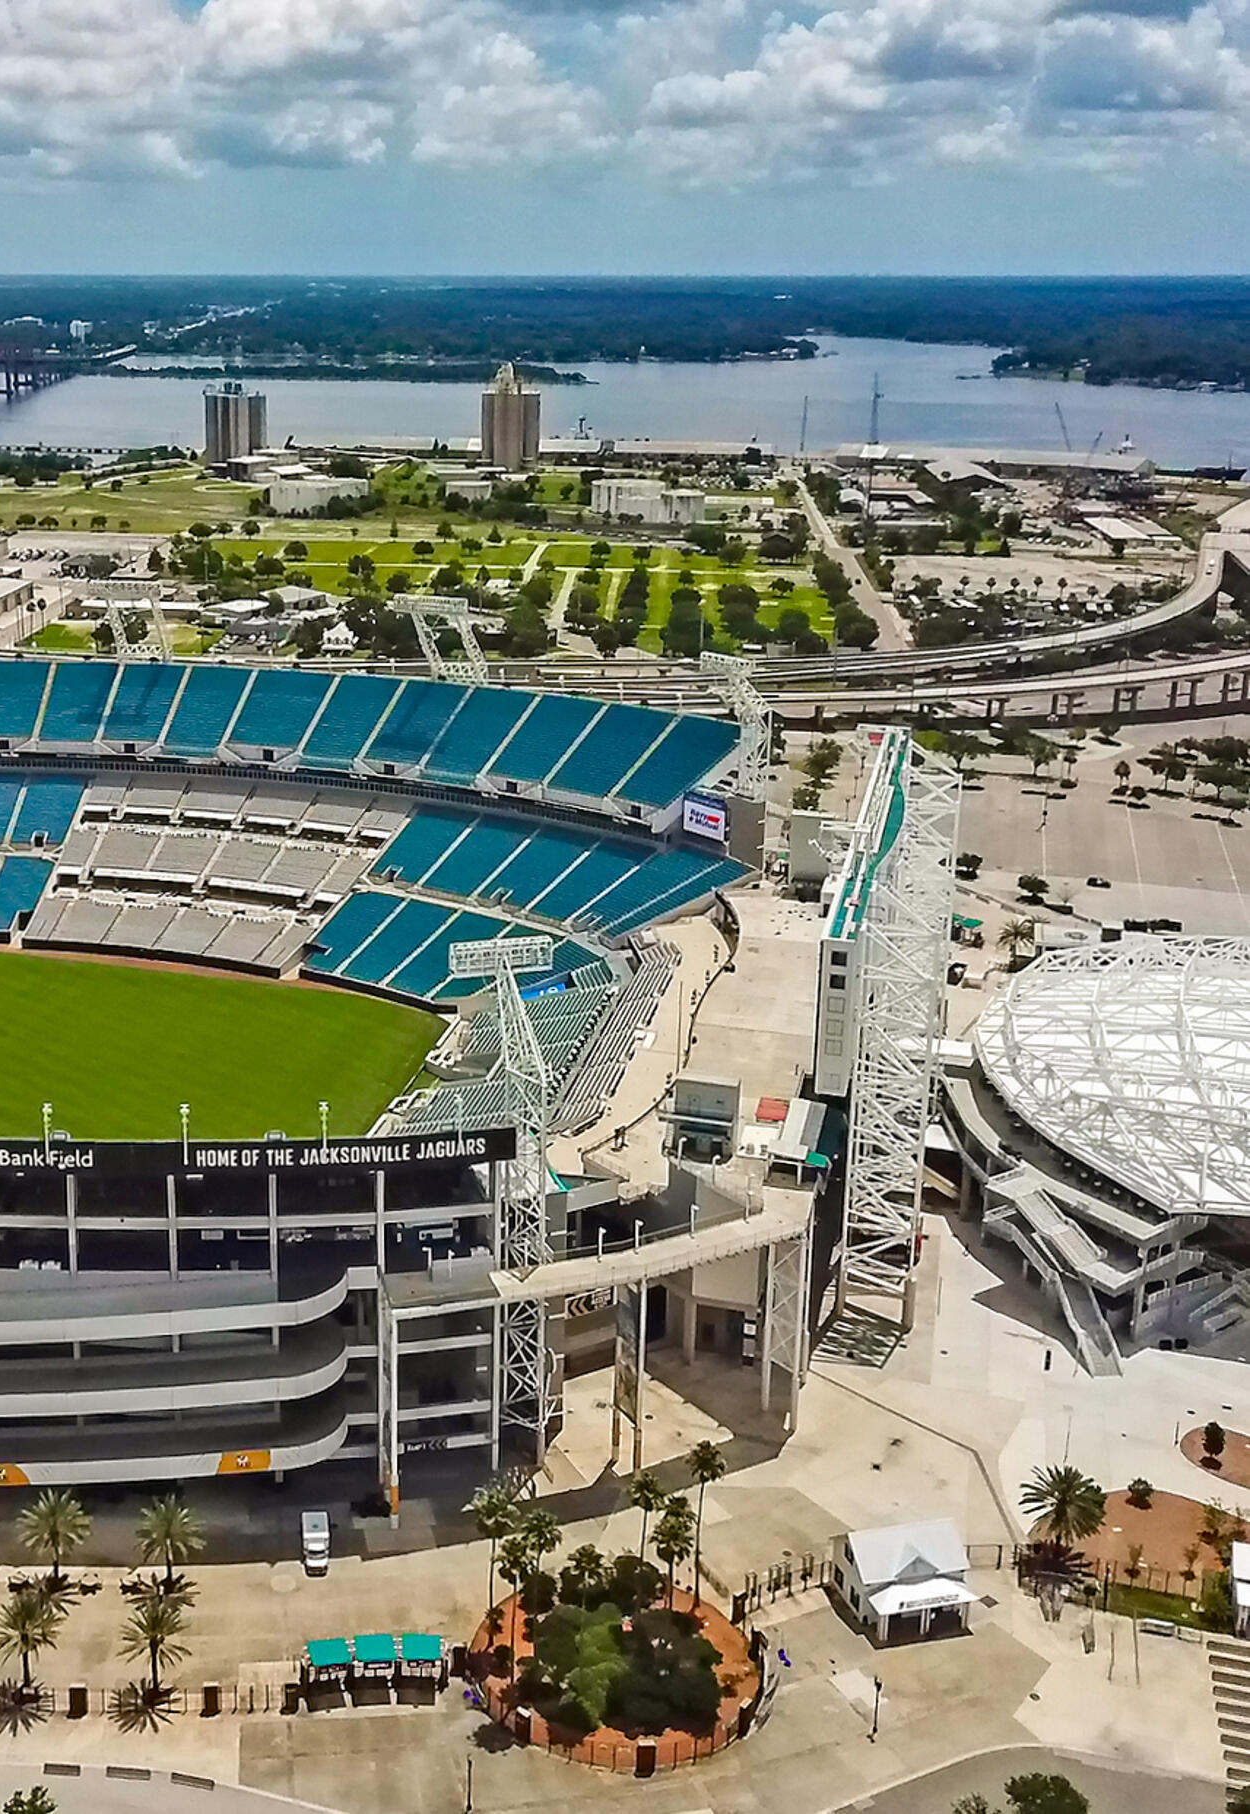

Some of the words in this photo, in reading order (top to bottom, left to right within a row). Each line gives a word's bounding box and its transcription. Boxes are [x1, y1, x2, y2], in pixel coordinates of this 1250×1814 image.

[0, 1148, 45, 1167] Bank
[50, 1149, 93, 1168] Field
[196, 1149, 238, 1167] HOME
[241, 1149, 260, 1166] OF
[266, 1148, 294, 1166] THE
[299, 1143, 411, 1166] JACKSONVILLE
[416, 1137, 486, 1160] JAGUARS
